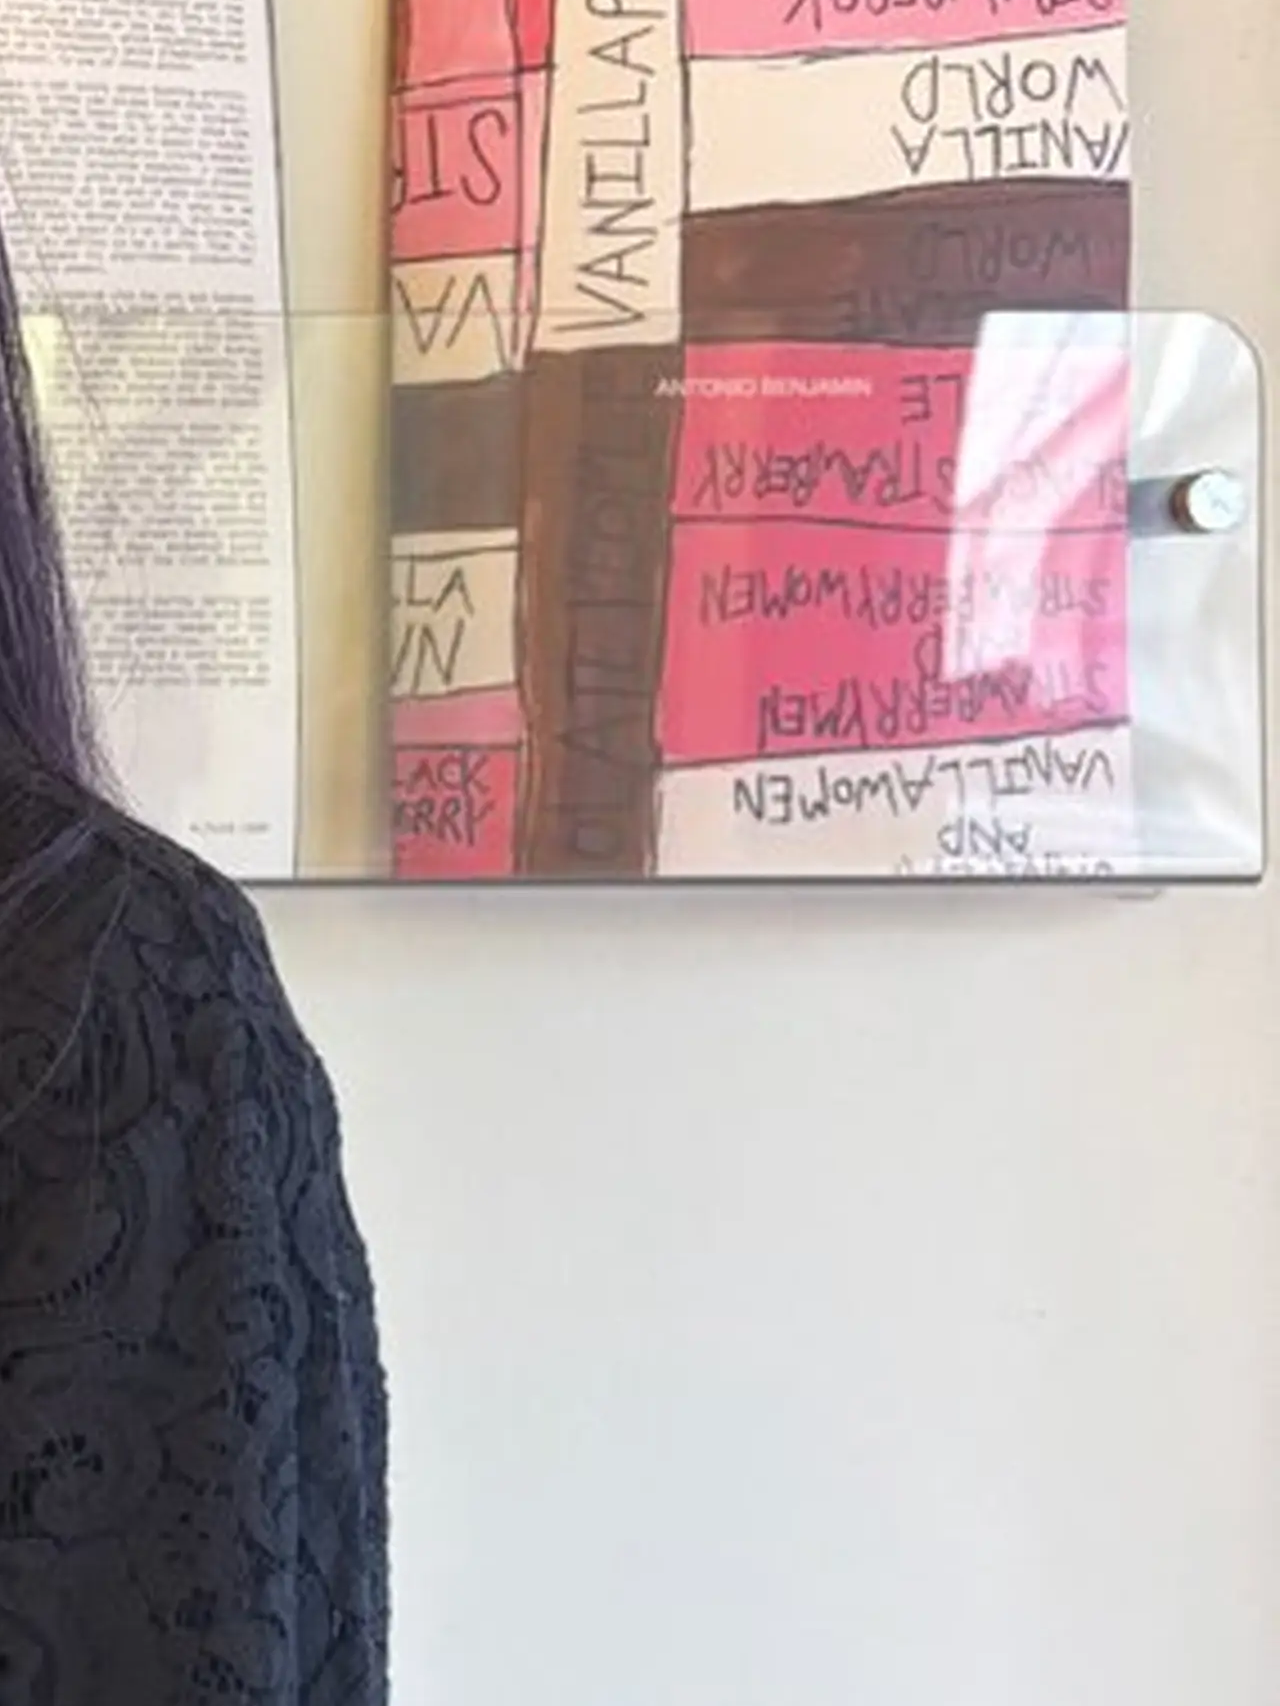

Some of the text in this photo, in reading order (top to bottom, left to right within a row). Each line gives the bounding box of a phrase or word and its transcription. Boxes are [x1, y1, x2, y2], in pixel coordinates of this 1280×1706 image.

[900, 51, 1126, 123] WORLD
[654, 376, 872, 399] ANTONIO BENJAMIN
[937, 816, 1034, 857] AND
